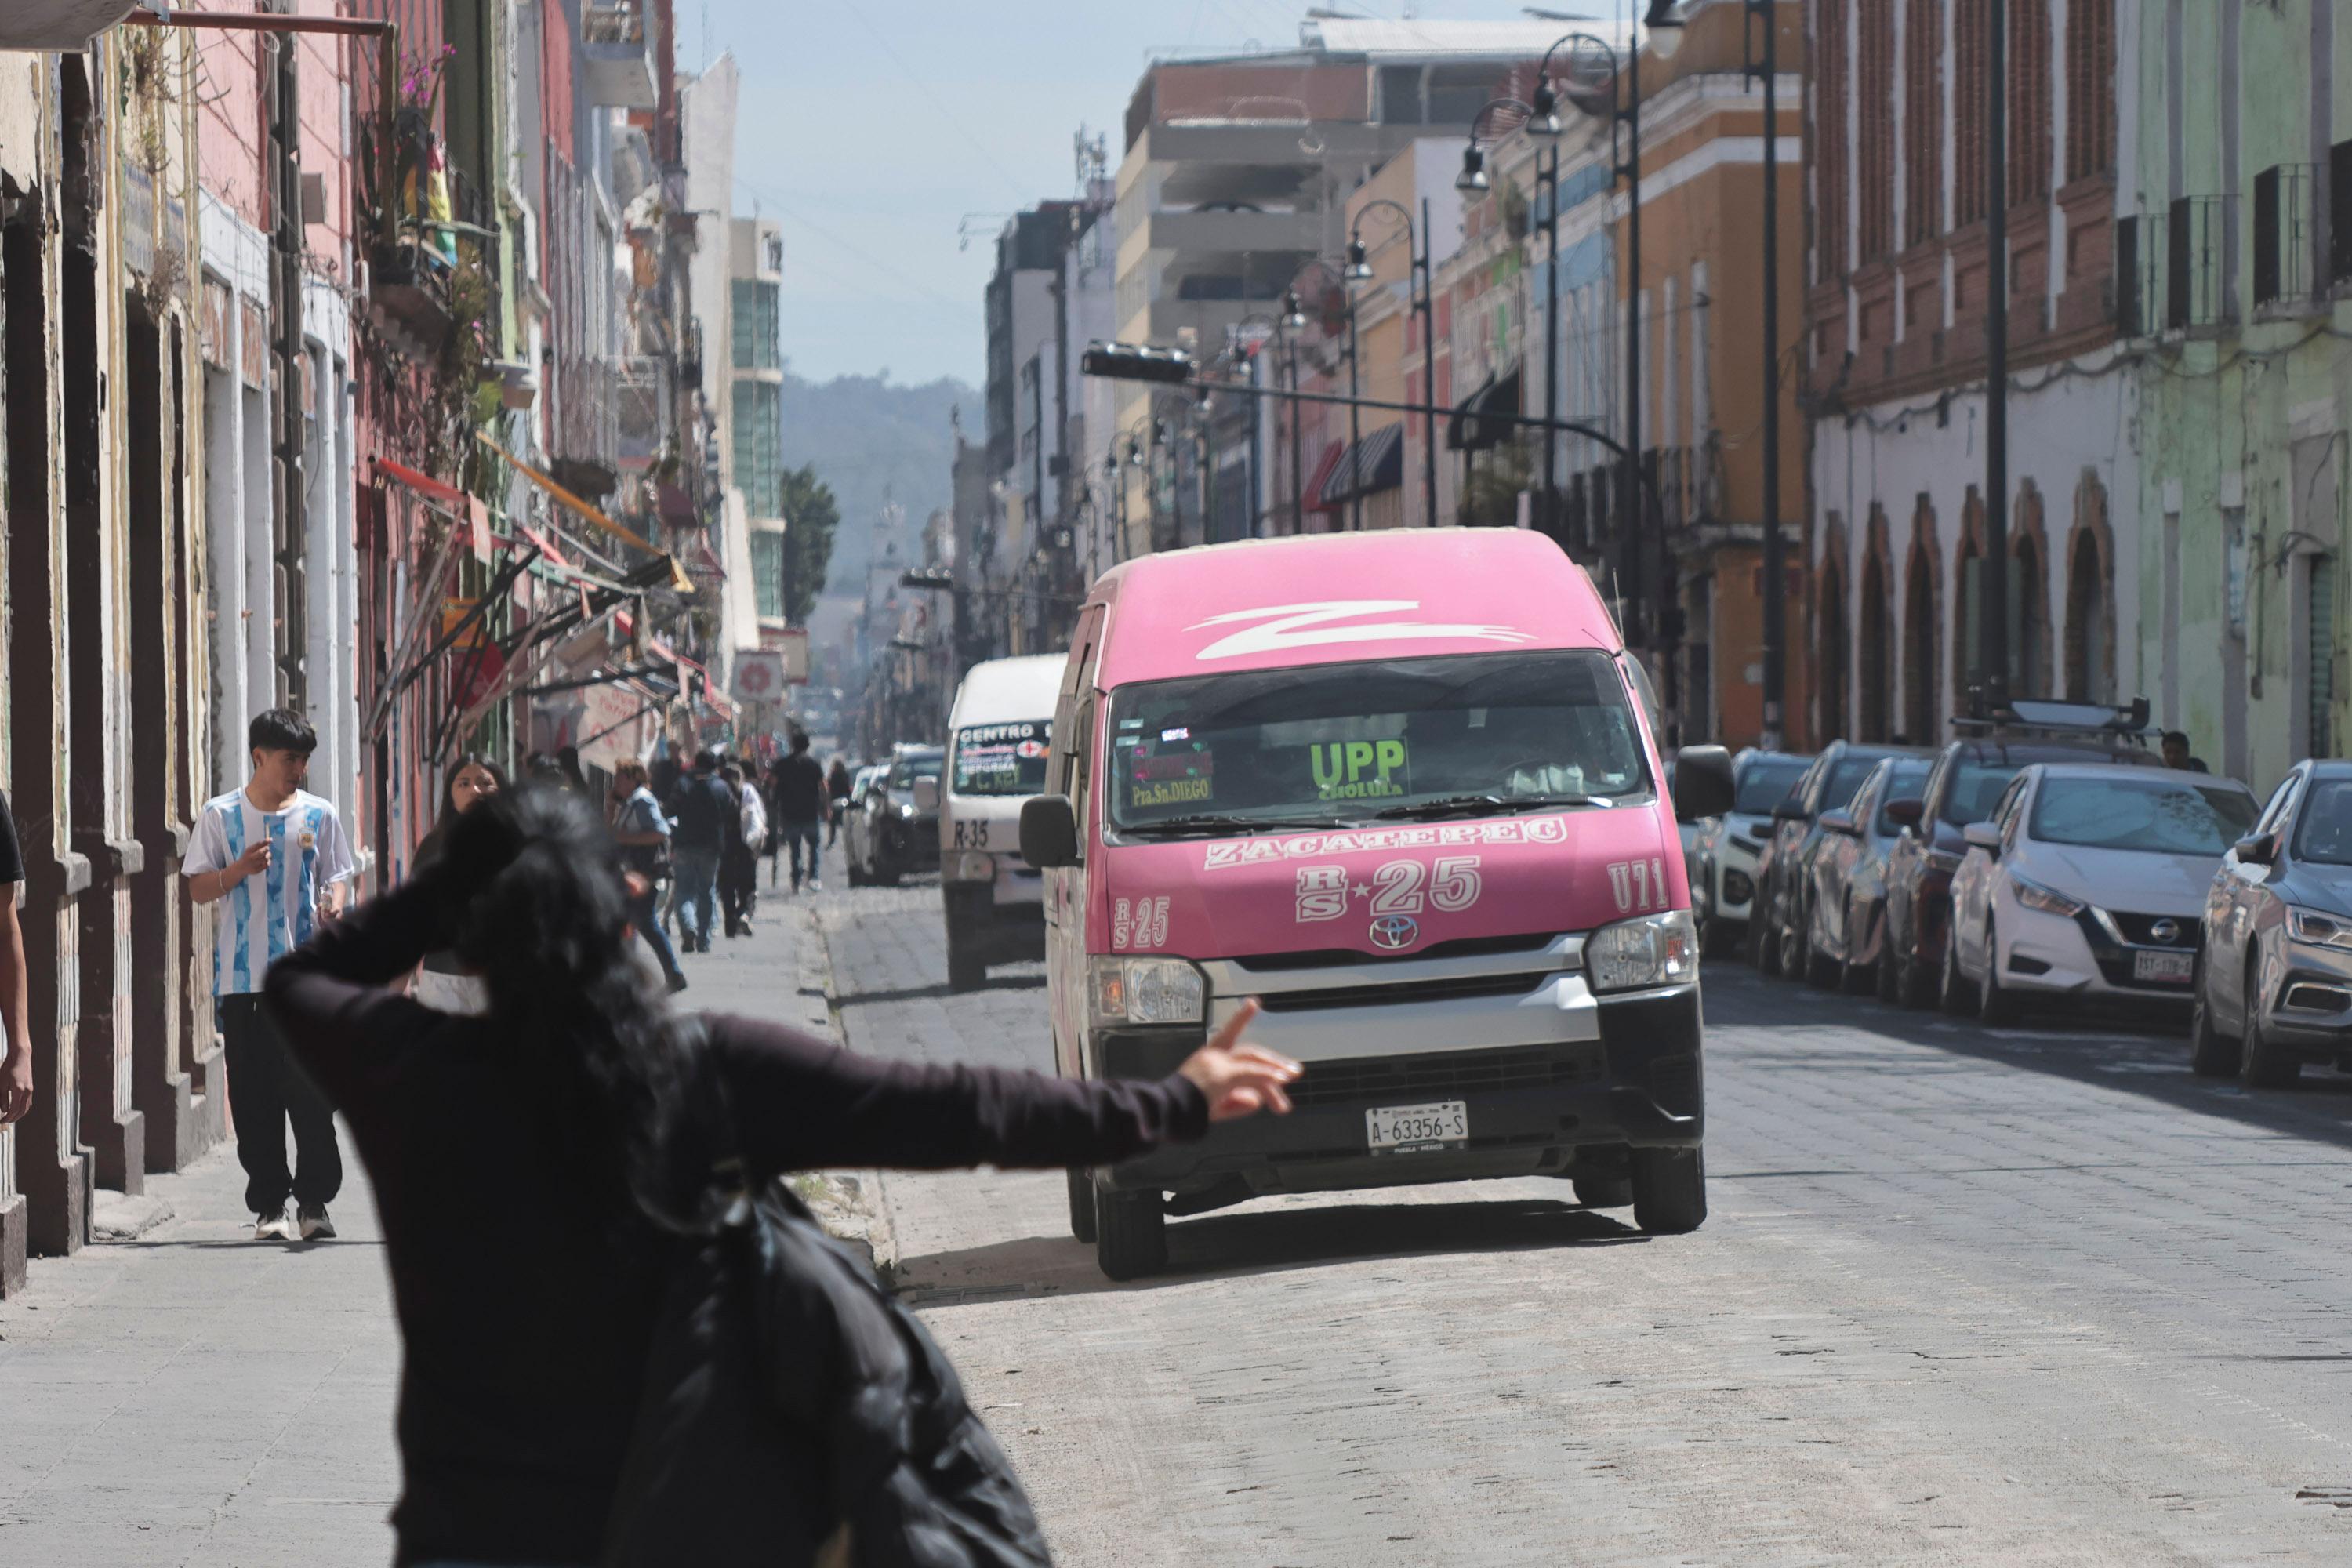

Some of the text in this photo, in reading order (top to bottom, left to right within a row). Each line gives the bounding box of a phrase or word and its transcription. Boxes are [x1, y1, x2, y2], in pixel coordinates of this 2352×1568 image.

[960, 724, 1034, 742] CENTRO
[1310, 739, 1405, 786] UPP
[1204, 816, 1568, 870] ZACATEPEC
[1606, 858, 1668, 913] U71
[1373, 1115, 1464, 1143] A-63356-S
[1394, 1145, 1416, 1154] PUEBLA
